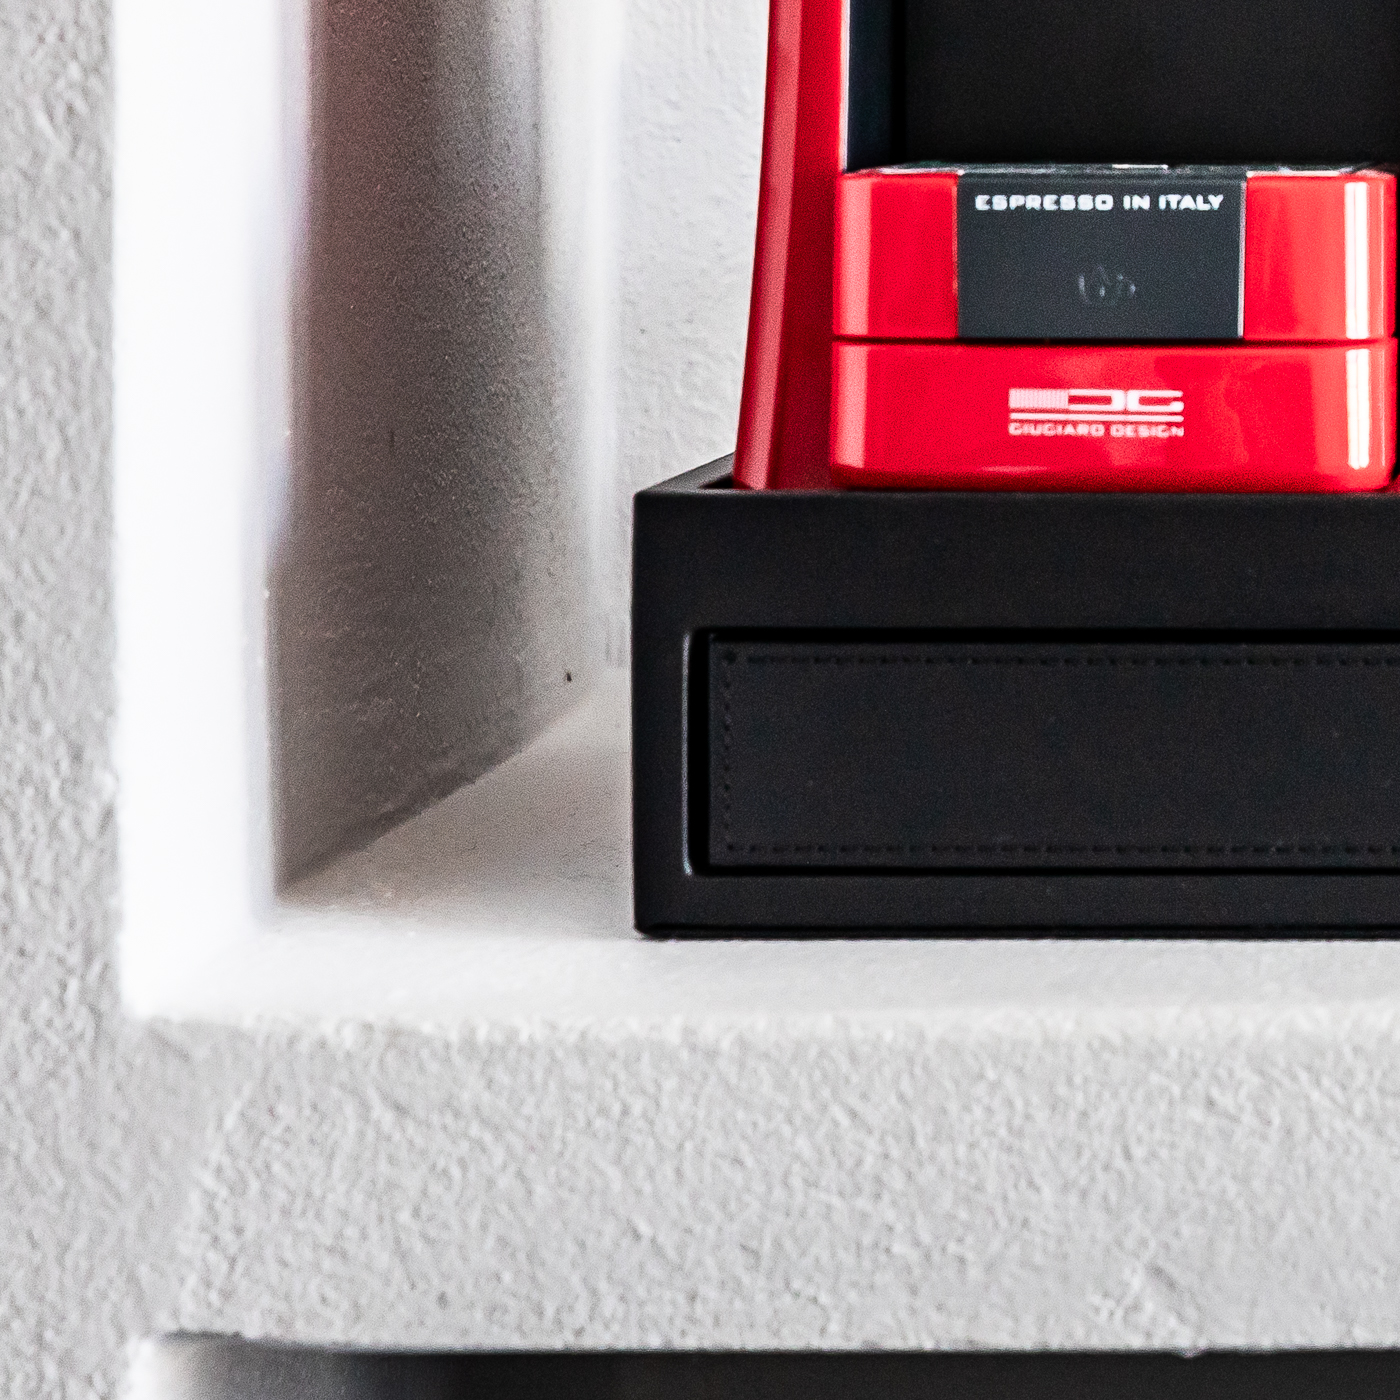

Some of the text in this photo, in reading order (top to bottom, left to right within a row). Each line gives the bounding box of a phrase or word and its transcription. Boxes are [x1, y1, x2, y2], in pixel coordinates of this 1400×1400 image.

[974, 194, 1225, 211] ESPRESSO IN ITALY
[1110, 424, 1185, 438] DESIGN
